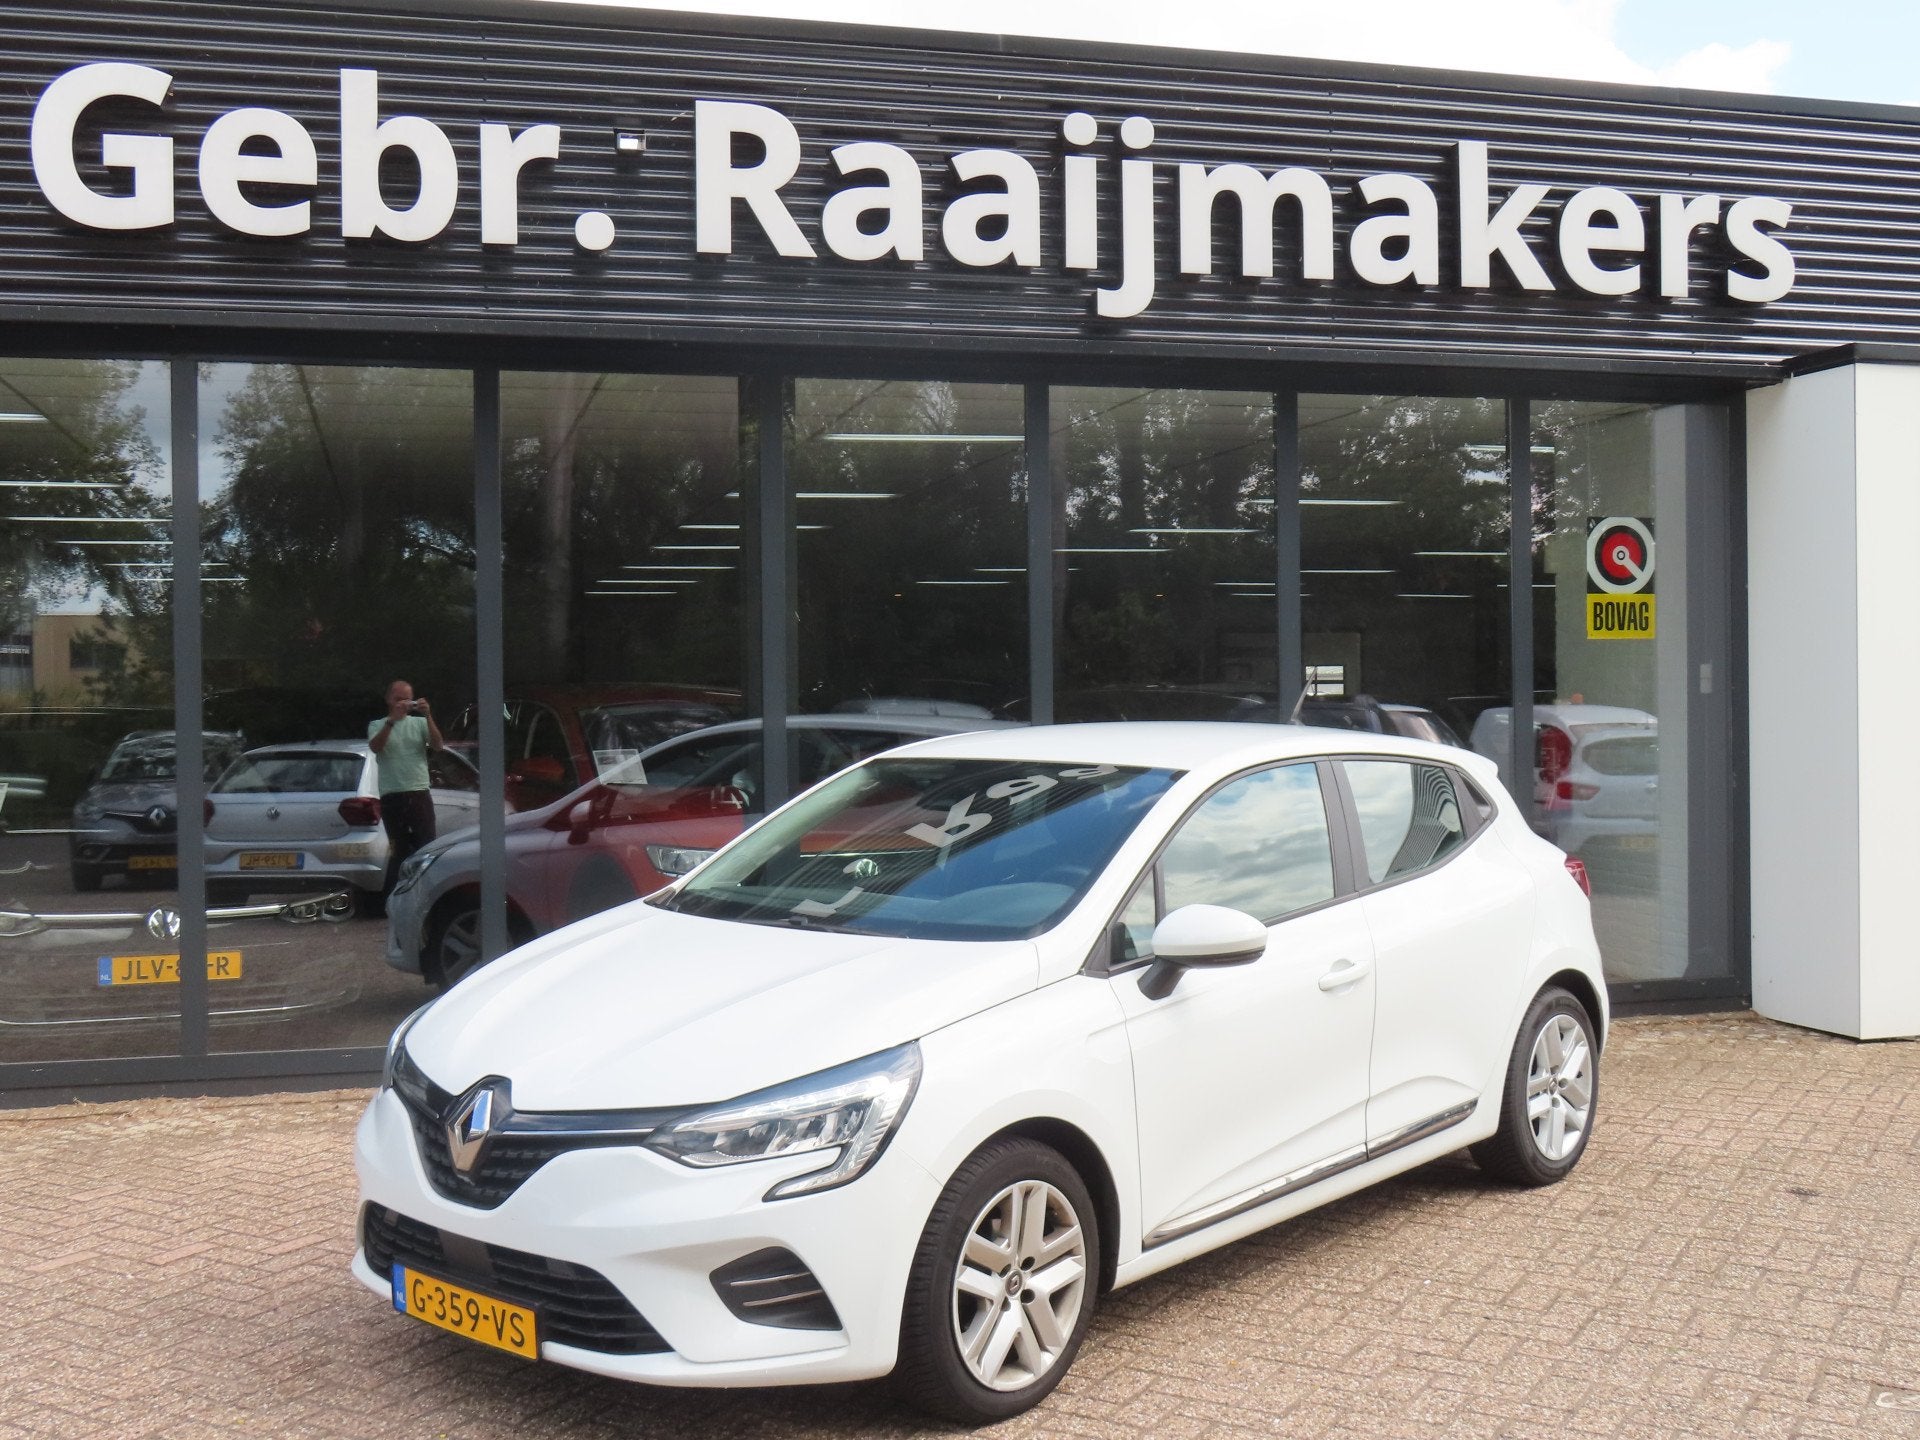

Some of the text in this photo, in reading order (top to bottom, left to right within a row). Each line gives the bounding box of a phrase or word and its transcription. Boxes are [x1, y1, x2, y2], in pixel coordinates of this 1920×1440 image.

[30, 62, 1797, 319] Gebr. Raaijmakers
[1593, 601, 1649, 631] BOVAG
[412, 1278, 526, 1348] G-359-VS
